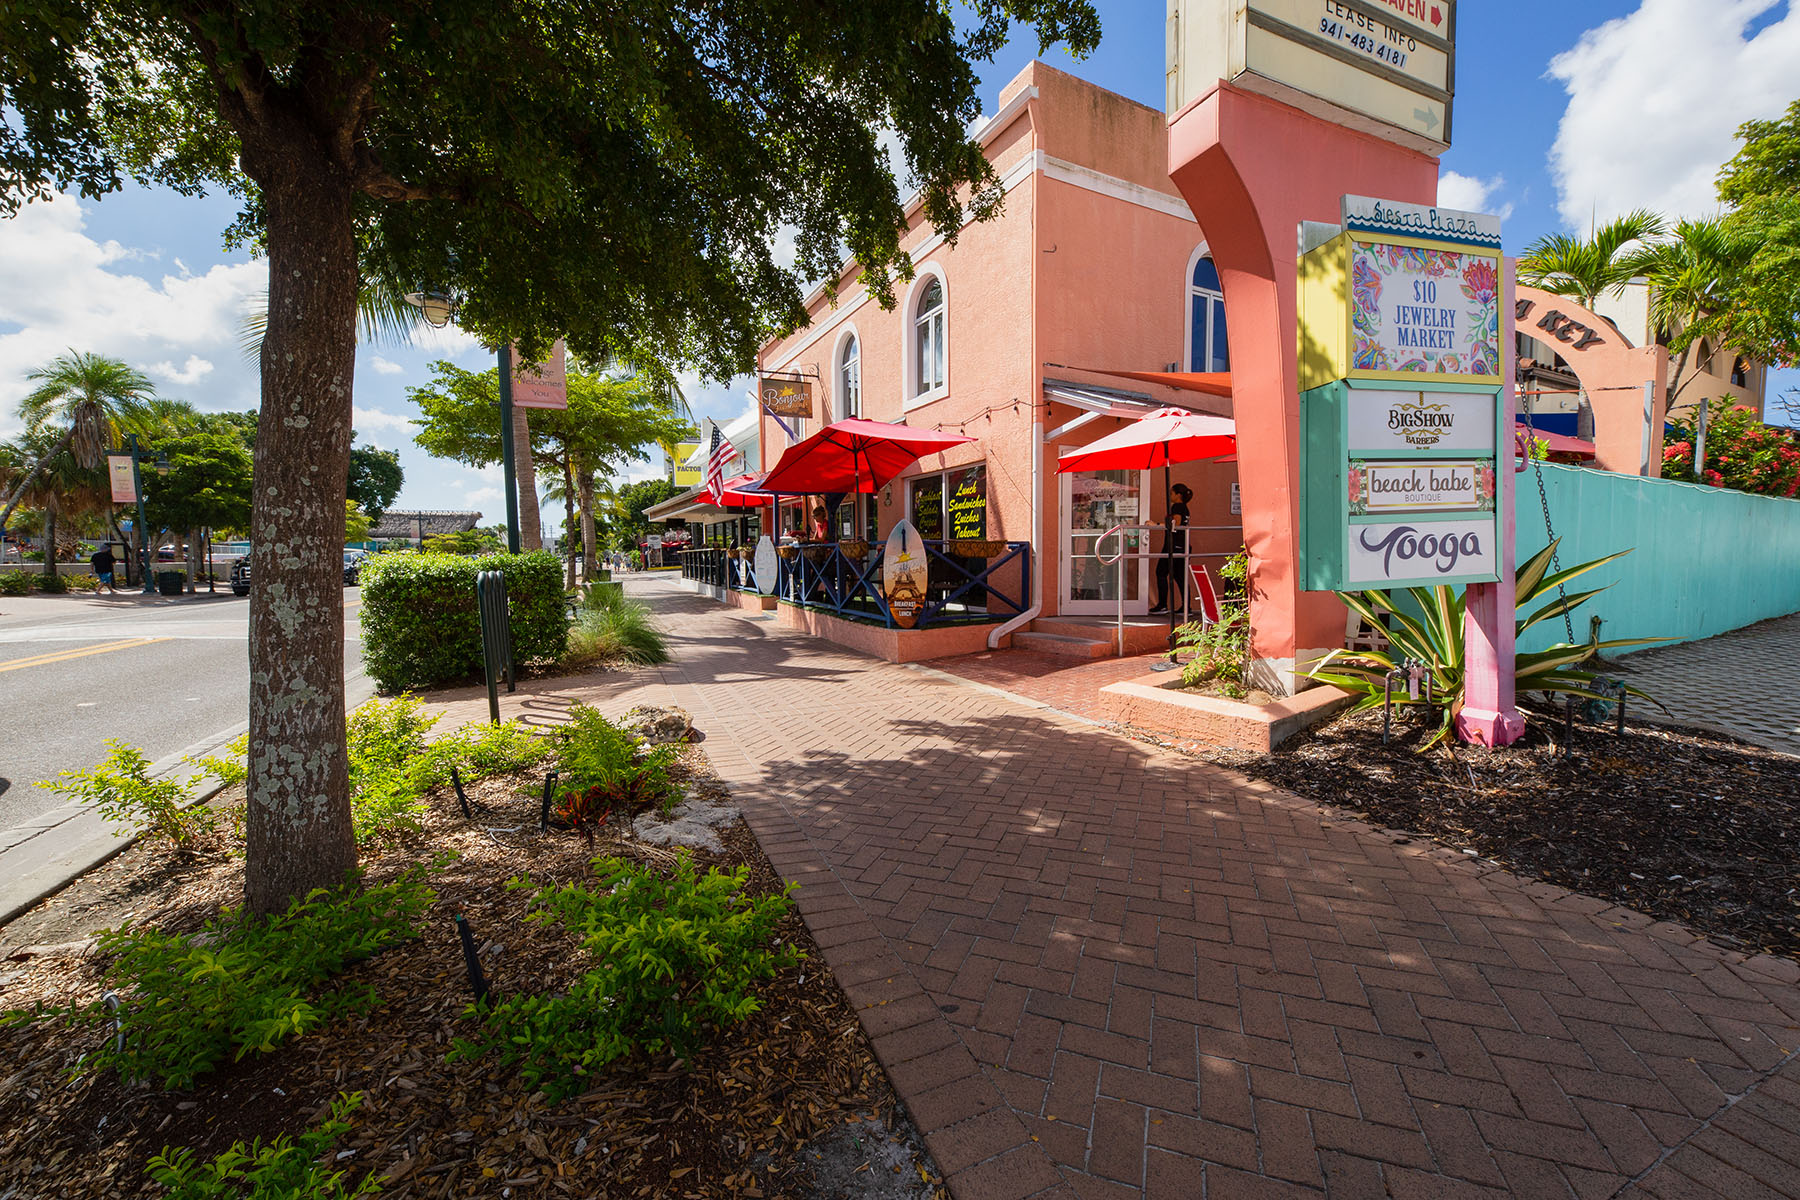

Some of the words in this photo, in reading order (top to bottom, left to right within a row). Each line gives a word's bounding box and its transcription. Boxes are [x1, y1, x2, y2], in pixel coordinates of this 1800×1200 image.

[1380, 0, 1426, 21] VEN
[1326, 0, 1375, 33] LEASE
[1384, 25, 1416, 52] INFO
[1320, 18, 1374, 53] 941-483
[1376, 44, 1406, 67] 4181
[1413, 279, 1437, 304] $10
[1393, 305, 1457, 330] JEWELRY
[1397, 326, 1455, 350] MARKET
[1536, 310, 1604, 350] KEY
[762, 388, 809, 408] Bonjour
[1405, 435, 1440, 445] BARBERS
[955, 480, 977, 497] Lunch
[1371, 469, 1425, 493] beach
[1429, 469, 1472, 492] babe
[948, 494, 986, 512] Sandwiches
[1404, 493, 1442, 503] BOUTIQUE
[954, 510, 980, 525] Quiches
[954, 525, 981, 539] Takeout
